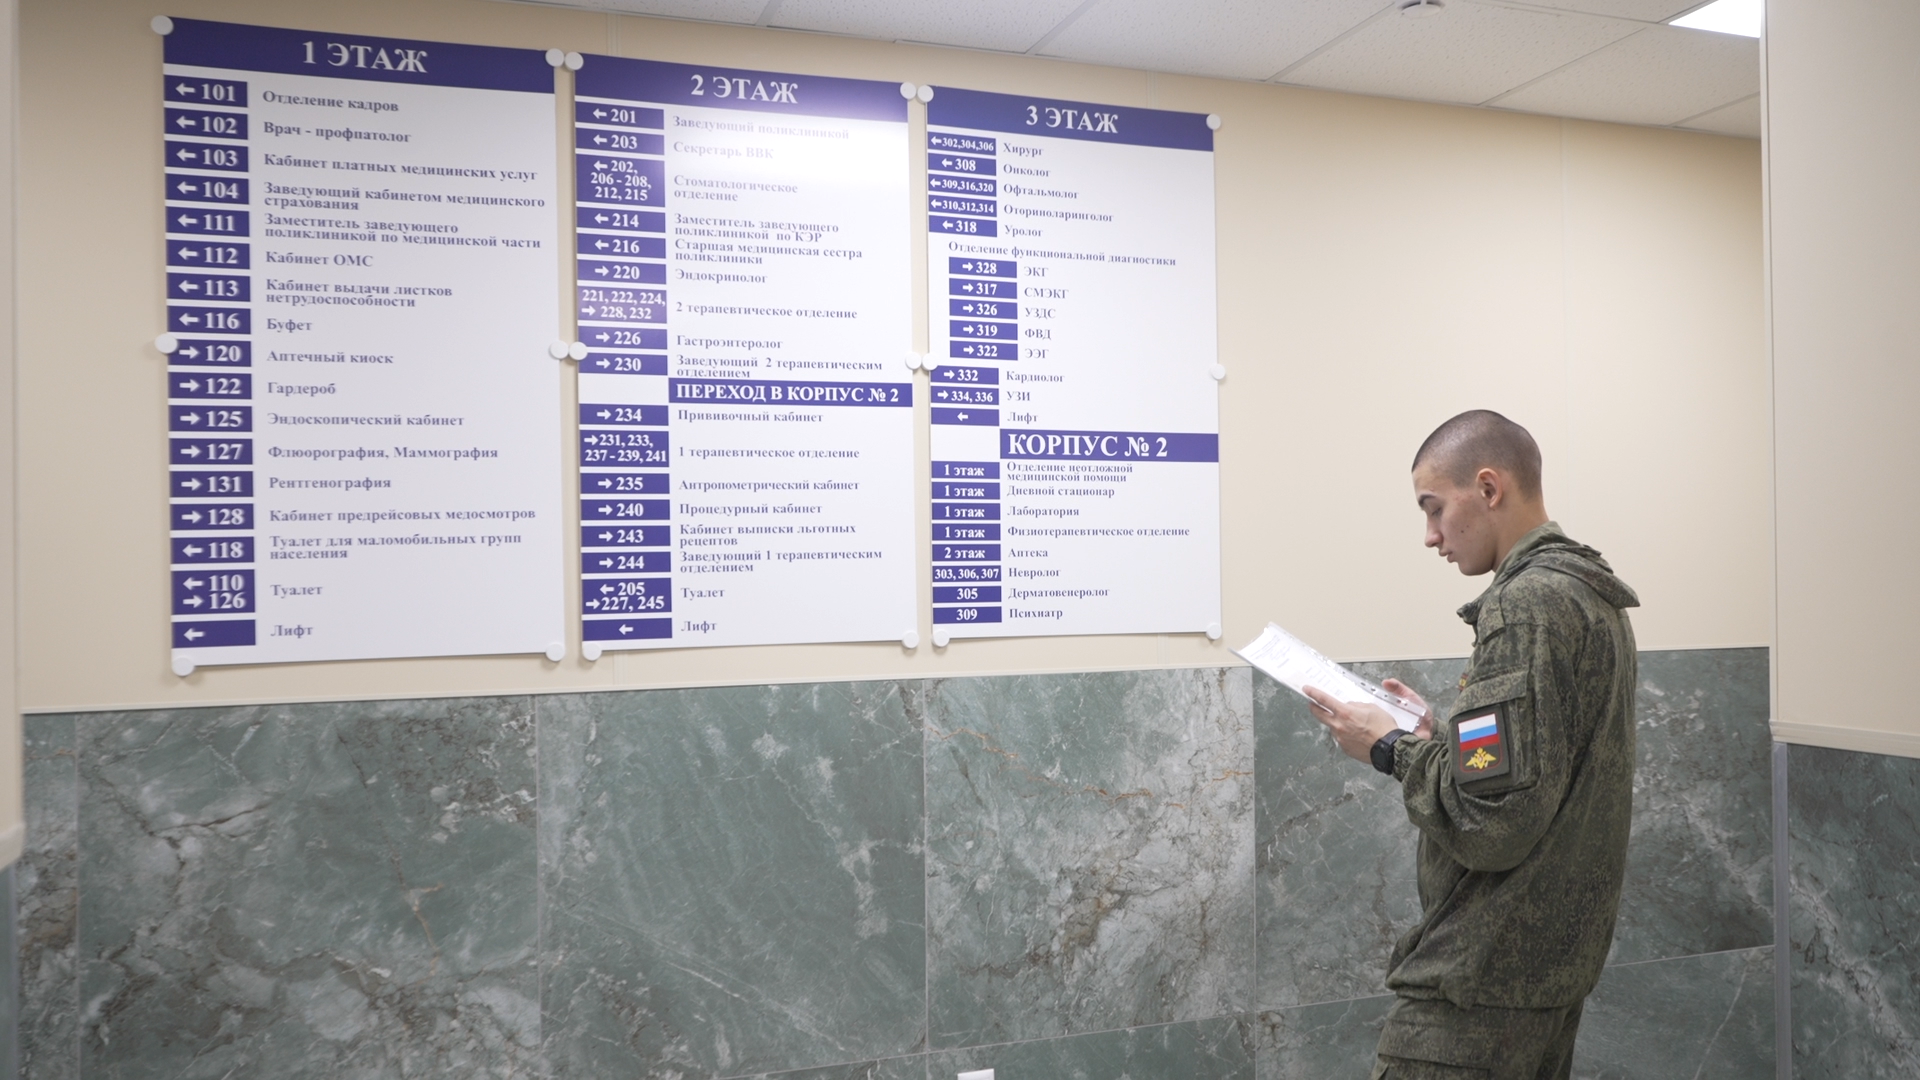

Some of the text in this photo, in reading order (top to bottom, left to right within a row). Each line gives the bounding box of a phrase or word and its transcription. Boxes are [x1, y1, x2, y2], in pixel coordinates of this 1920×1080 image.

[303, 42, 427, 72] 1 ЭТАЖ
[202, 84, 235, 101] 101
[691, 75, 799, 105] 2 ЭТАЖ
[263, 91, 399, 113] Отделение кадров
[611, 109, 635, 123] 201
[1026, 106, 1118, 133] 3 ЭТАЖ
[203, 116, 236, 134] 102
[612, 135, 637, 149] 203
[941, 136, 995, 153] 302,304,306
[1004, 143, 1042, 157] Хирург
[203, 149, 237, 166] 103
[264, 154, 537, 182] Кабинет платных медицинских услуг
[611, 160, 638, 174] 202,
[955, 159, 976, 171] 308
[1003, 164, 1050, 177] Онколог
[203, 182, 238, 198] 104
[673, 175, 797, 195] Стоматологическое
[941, 178, 995, 195] 309,316,320
[1004, 184, 1078, 199] Офтальмолог
[265, 182, 545, 207] Заведующий кабинетом медицинского
[595, 186, 647, 201] 212, 215
[674, 190, 738, 201] отделение
[941, 199, 995, 216] 310,312,314
[1004, 205, 1113, 222] Оториноларинголог
[204, 214, 234, 231] 111
[613, 213, 639, 227] 214
[956, 220, 976, 233] 318
[1005, 225, 1042, 237] Уролог
[613, 239, 639, 253] 216
[205, 247, 238, 264] 112
[266, 251, 372, 266] Кабинет ОМС
[949, 242, 1175, 265] Отделение функциональной диагностики
[613, 265, 640, 279] 220
[976, 262, 997, 274] 328
[1024, 267, 1048, 277] ЭКГ
[676, 269, 767, 284] Эндокринолог
[205, 280, 238, 296] 113
[976, 283, 997, 295] 317
[1024, 288, 1068, 298] СМЭКГ
[582, 290, 665, 306] 221, 222, 224,
[601, 306, 651, 319] 228, 232
[677, 302, 857, 318] 2 терапевтическое отделение
[977, 303, 997, 315] 326
[1025, 308, 1056, 319] УЗДС
[206, 313, 239, 329] 116
[267, 318, 312, 333] Буфет
[977, 324, 997, 336] 319
[1025, 329, 1051, 340] ФВД
[614, 331, 641, 345] 226
[677, 335, 782, 350] Гастроэнтеролог
[206, 345, 241, 361] 120
[267, 351, 393, 363] Аптечный киоск
[977, 345, 997, 356] 322
[1026, 349, 1048, 358] ЭЭГ
[615, 358, 641, 371] 230
[958, 369, 978, 381] 332
[1007, 371, 1064, 383] Кардиолог
[207, 378, 240, 394] 122
[268, 382, 336, 397] Гардероб
[677, 384, 900, 403] ПЕРЕХОД В КОРПУС № 2
[951, 391, 993, 402] 334, 336
[1007, 391, 1030, 401] УЗИ
[207, 411, 242, 427] 125
[268, 413, 463, 425] Эндоскопический кабинет
[616, 408, 642, 421] 234
[679, 410, 823, 423] Прививочный кабинет
[1008, 412, 1038, 424] Лифт
[600, 434, 653, 447] 231, 233,
[1008, 434, 1169, 458] КОРПУС № 2
[207, 444, 242, 459] 127
[268, 446, 497, 461] Флюорография, Маммография
[943, 464, 984, 477] 1 этаж
[208, 476, 240, 492] 131
[270, 477, 391, 491] Рентгенография
[617, 477, 643, 490] 235
[680, 480, 858, 492] Антропометрический кабинет
[943, 485, 984, 497] 1 этаж
[1007, 486, 1114, 498] Дневной стационар
[270, 510, 535, 523] Кабинет предрейсовых медосмотров
[617, 503, 643, 516] 240
[680, 503, 821, 517] Процедурный кабинет
[1007, 506, 1079, 518] Лаборатория
[209, 509, 244, 525] 128
[617, 529, 643, 543] 243
[1008, 526, 1134, 538] Физиотерапевтическое
[270, 534, 521, 550] Туалет для маломобильных групп
[209, 542, 243, 558] 118
[270, 548, 347, 559] населения
[943, 547, 985, 559] 2 этаж
[1010, 549, 1048, 557] Аптека
[618, 556, 644, 569] 244
[934, 567, 999, 581] 303, 306, 307
[1009, 568, 1060, 579] Невролог
[209, 575, 243, 591] 110
[618, 582, 645, 595] 205
[270, 585, 322, 599] Туалет
[681, 588, 724, 600] Туалет
[957, 588, 978, 599] 305
[1008, 588, 1109, 600] Дерматовенеролог
[210, 592, 245, 609] 126
[602, 596, 664, 611] 227, 245
[957, 609, 977, 620] 309
[1010, 609, 1063, 620] Психиатр
[271, 625, 312, 639] Лифт
[681, 621, 716, 633] Лифт
